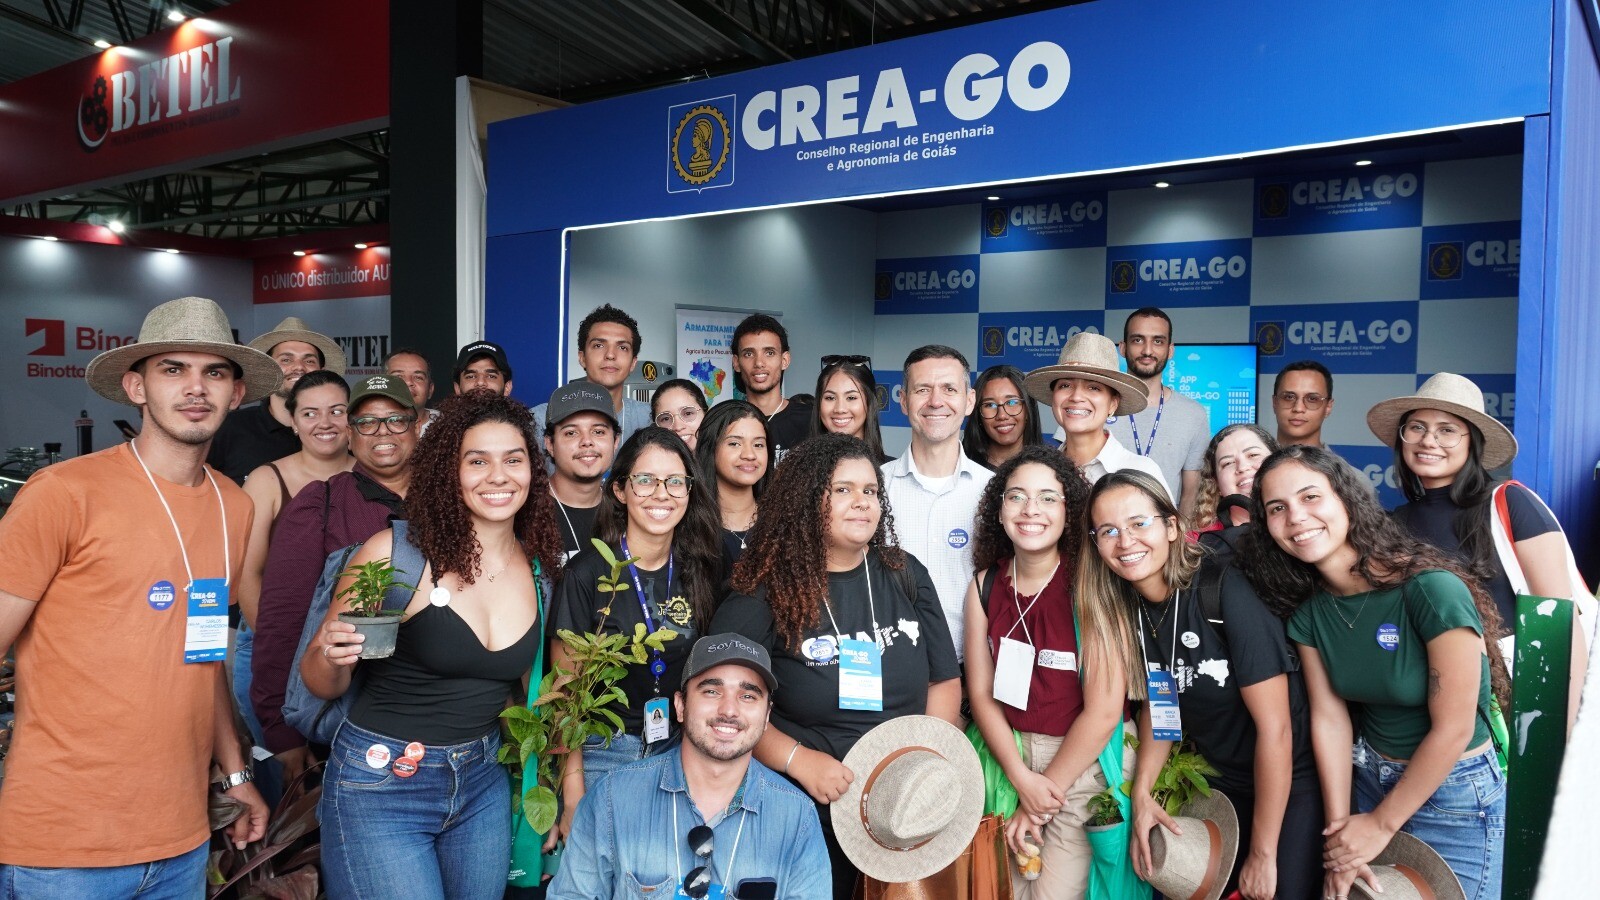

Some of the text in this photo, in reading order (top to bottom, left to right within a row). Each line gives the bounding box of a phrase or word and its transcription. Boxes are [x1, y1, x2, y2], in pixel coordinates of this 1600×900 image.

[111, 36, 241, 133] BETEL
[742, 41, 1071, 150] CREA-GO
[796, 124, 994, 161] Conselho Regional de Engenharia
[827, 145, 957, 172] e Agronomia de Goiás
[1292, 172, 1418, 205] CREA-GO
[1010, 200, 1103, 226] CREA-GO
[1466, 238, 1520, 267] CRE
[261, 263, 391, 290] O ÚNICO distribuidor AU
[895, 269, 976, 291] CREA-GO
[1139, 255, 1246, 281] CREA-GO
[684, 322, 736, 333] ARMAZENAMEN
[1287, 319, 1412, 345] CREA-GO
[333, 335, 388, 368] ETEL
[704, 338, 722, 346] PARA
[27, 363, 86, 378] Binotto
[1180, 376, 1197, 384] APP
[1179, 383, 1191, 391] do
[1180, 391, 1220, 400] REA-GO
[1483, 392, 1516, 418] RE
[707, 639, 760, 658] SoyTech
